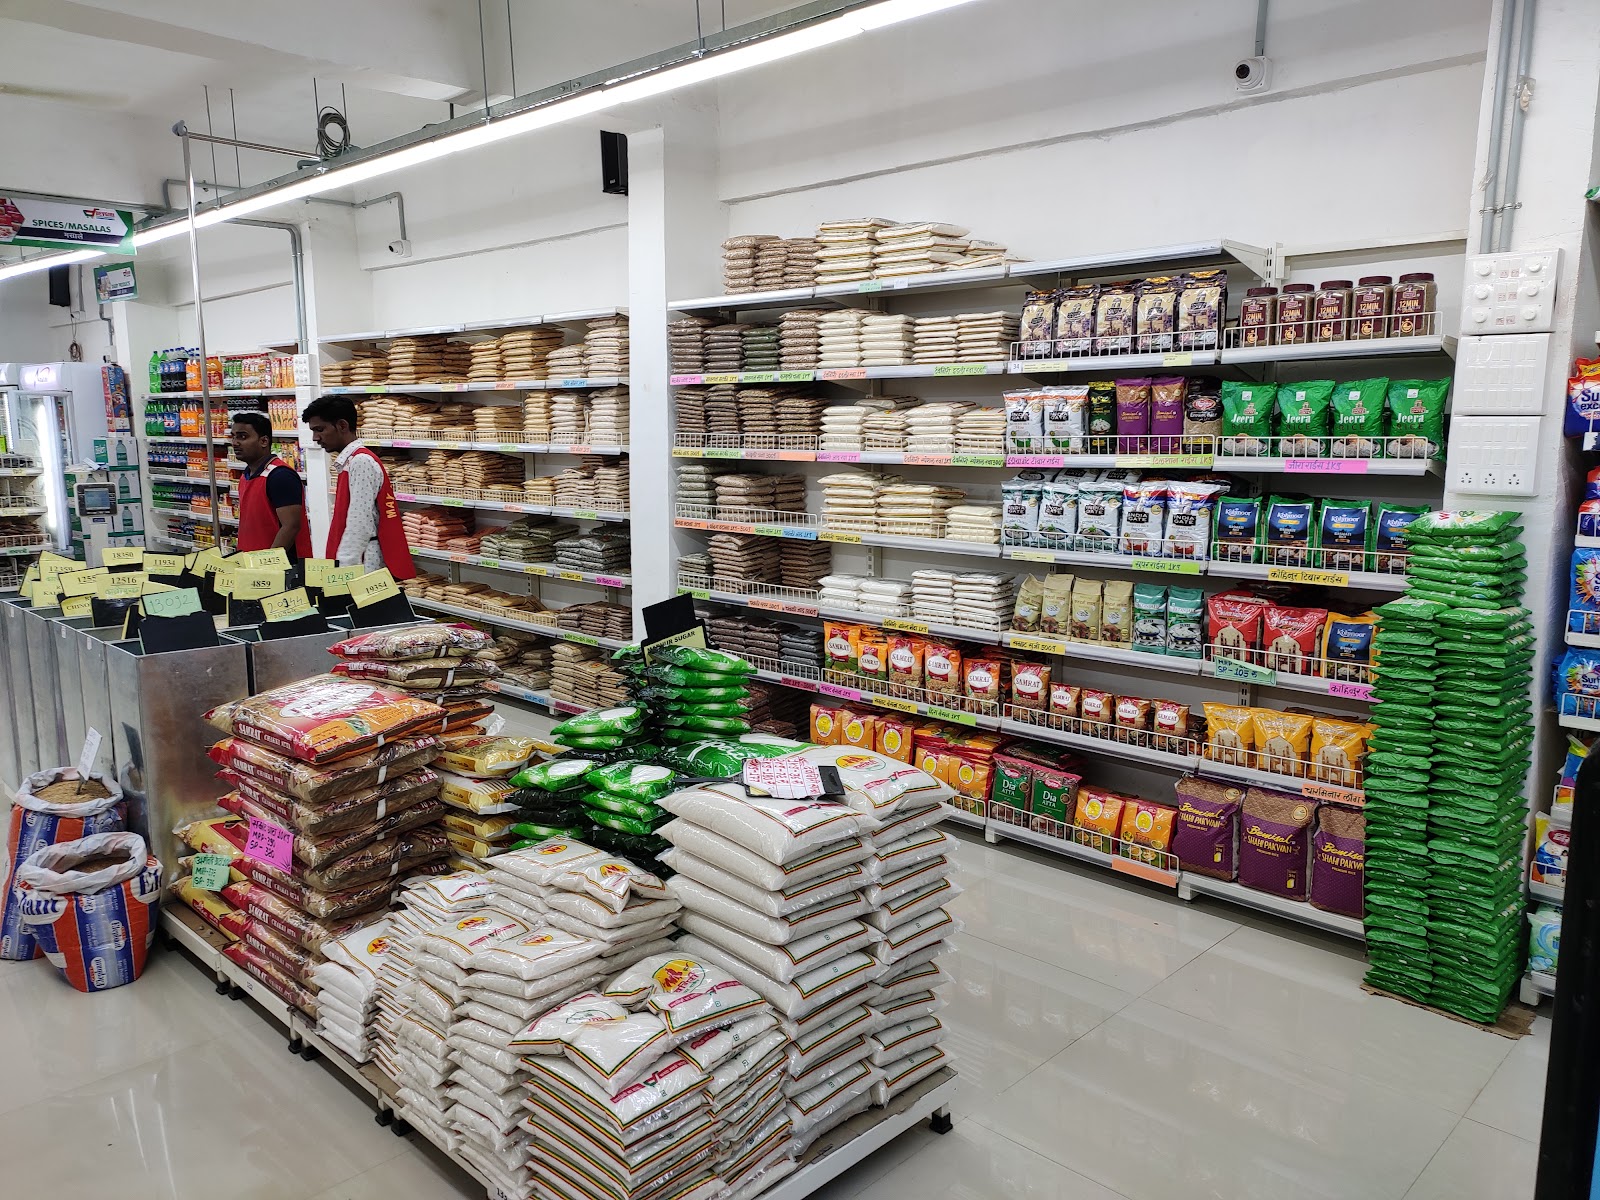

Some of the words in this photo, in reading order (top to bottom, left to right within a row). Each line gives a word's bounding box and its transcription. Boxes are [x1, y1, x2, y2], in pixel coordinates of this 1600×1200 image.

[32, 219, 111, 233] SPICES/MASALAS
[64, 232, 84, 240] मसाले
[1580, 389, 1600, 402] Su
[1580, 402, 1600, 410] exc
[1231, 413, 1254, 424] Jeera
[1286, 413, 1311, 424] Jeera
[1338, 413, 1365, 425] Jeera
[1396, 412, 1425, 424] Jeera
[1225, 507, 1252, 517] Kohinoor
[1277, 510, 1305, 520] Kohinoor
[1331, 513, 1360, 523] Kohinoor
[77, 575, 97, 584] 1255
[111, 577, 137, 585] 12516
[250, 580, 271, 588] 4859
[365, 581, 388, 594] 19354
[674, 631, 696, 643] SUGAR
[1336, 628, 1366, 638] Kohinoor
[828, 642, 849, 651] SAMRAT
[861, 657, 879, 665] SAMRAT
[928, 661, 950, 670] SAMRAT
[969, 675, 991, 684] SAMRAT
[1015, 678, 1041, 688] SAMRAT
[239, 724, 261, 741] SAMRAT
[233, 758, 256, 776] SAMRAT
[1002, 779, 1016, 791] Dia
[239, 781, 260, 802] SAMRAT
[1042, 790, 1057, 801] Dia
[1042, 800, 1056, 808] ATTA
[1194, 816, 1220, 828] PAKWAN
[1247, 825, 1295, 844] Bemisal
[1247, 836, 1264, 848] SHAHI
[1264, 839, 1292, 854] PAKWAN
[1322, 842, 1364, 861] Bemisa
[1321, 852, 1342, 867] SHAHI
[252, 870, 273, 889] SAMRAT
[248, 903, 269, 924] SAMRAT
[246, 933, 266, 955] SAMRAT
[247, 962, 267, 983] SAMRAT
